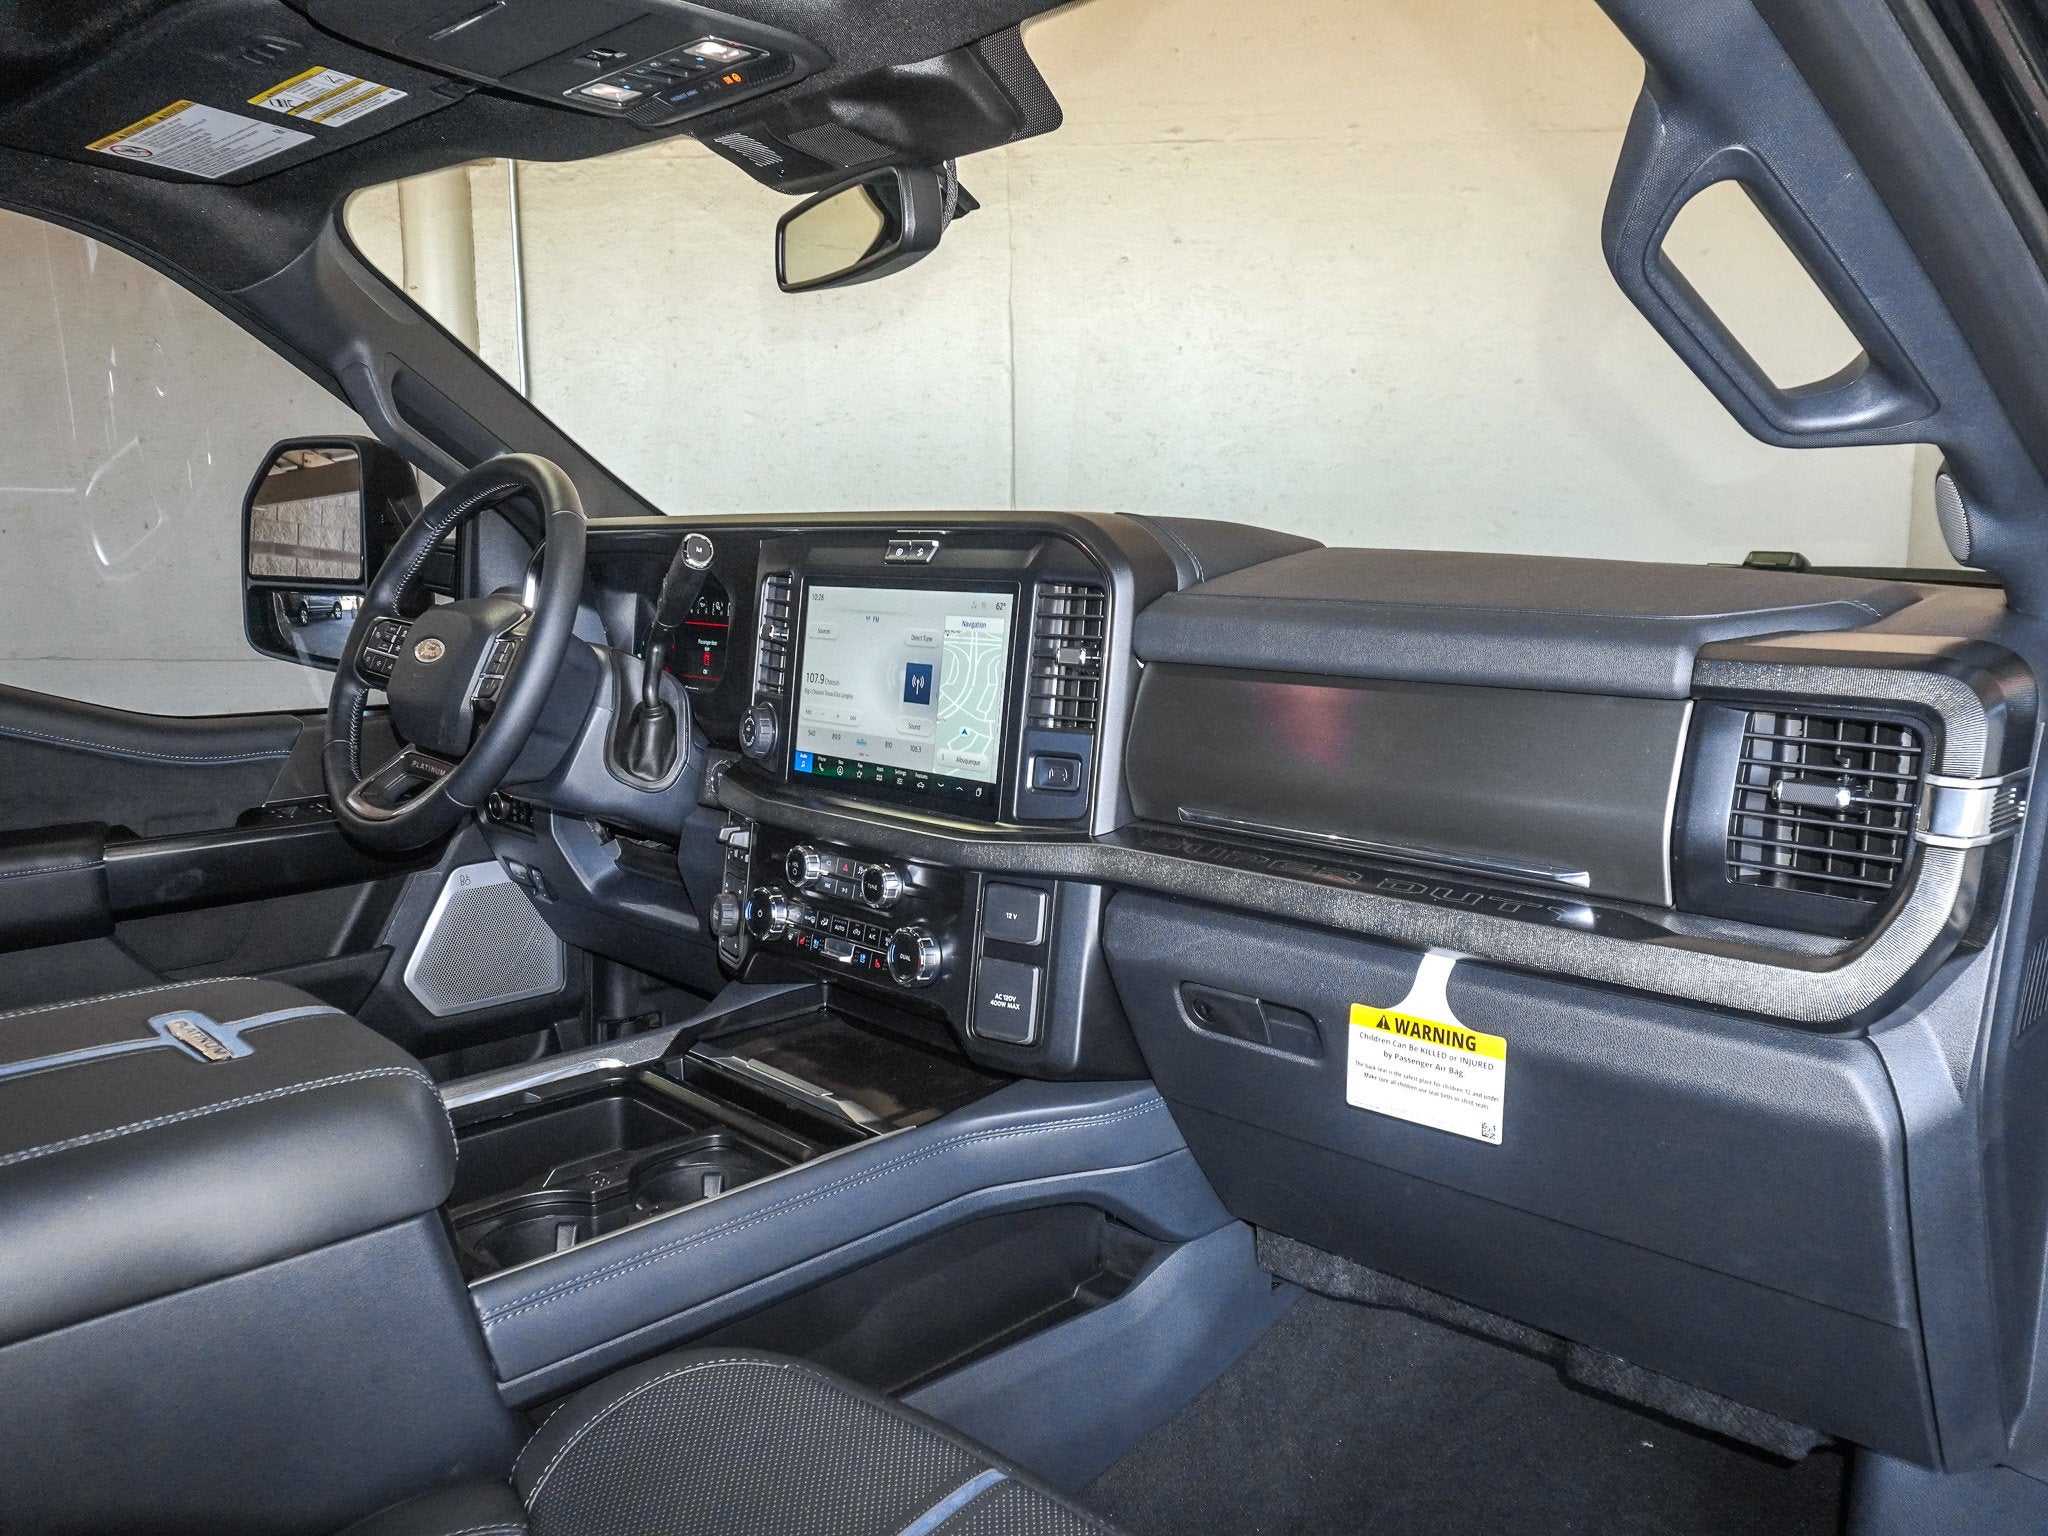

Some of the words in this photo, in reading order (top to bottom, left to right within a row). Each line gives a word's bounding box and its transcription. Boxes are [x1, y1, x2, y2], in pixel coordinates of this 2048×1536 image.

[811, 593, 824, 601] 10:28
[961, 620, 987, 629] Navigation
[806, 672, 825, 685] 107.9
[908, 723, 921, 731] Sound
[956, 756, 981, 766] Albuquerque
[411, 760, 446, 776] PLATINUM
[1005, 912, 1012, 920] 12
[994, 993, 1002, 1001] AC
[1002, 994, 1017, 1003] 120V
[990, 999, 1007, 1008] 400W
[1007, 1002, 1020, 1010] MAX
[1394, 1017, 1477, 1052] WARNING
[1359, 1031, 1391, 1045] Children
[1392, 1040, 1407, 1049] Can
[1408, 1043, 1419, 1052] Be
[1420, 1047, 1447, 1060] KILLED
[1459, 1057, 1494, 1071] INJURED
[1383, 1050, 1392, 1060] by
[1394, 1053, 1433, 1069] Passenger
[1435, 1063, 1446, 1072] Air
